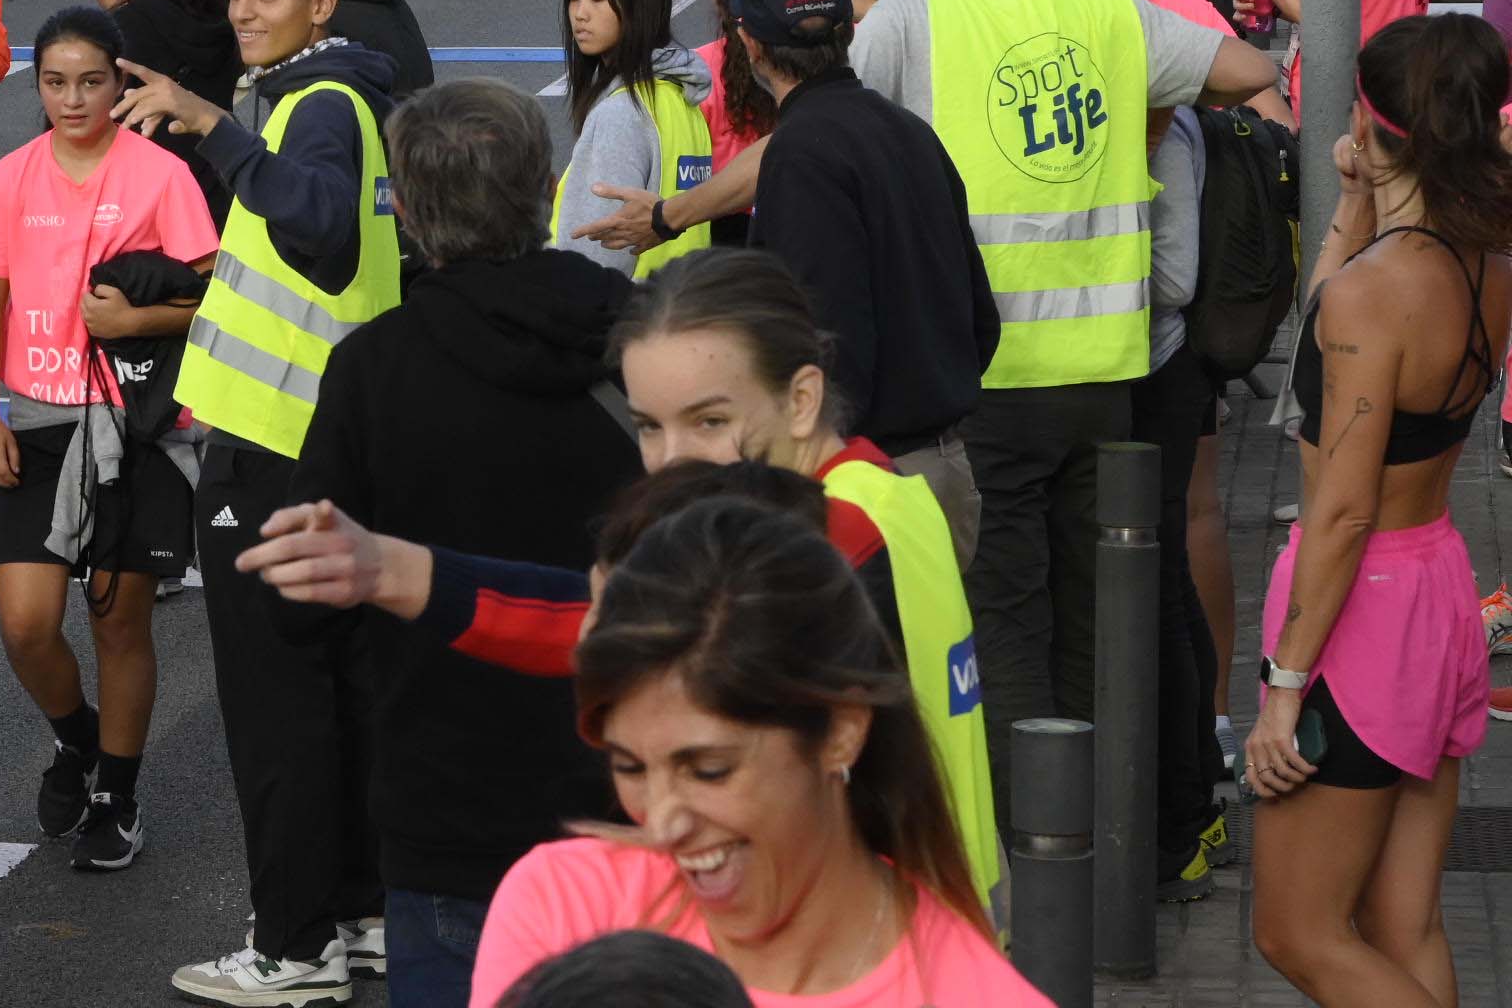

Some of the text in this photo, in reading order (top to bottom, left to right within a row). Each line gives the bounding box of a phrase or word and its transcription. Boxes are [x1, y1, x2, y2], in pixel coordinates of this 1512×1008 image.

[1018, 82, 1109, 159] Life
[25, 309, 54, 336] TU
[211, 518, 240, 528] adidas
[150, 550, 175, 559] KIPSTA
